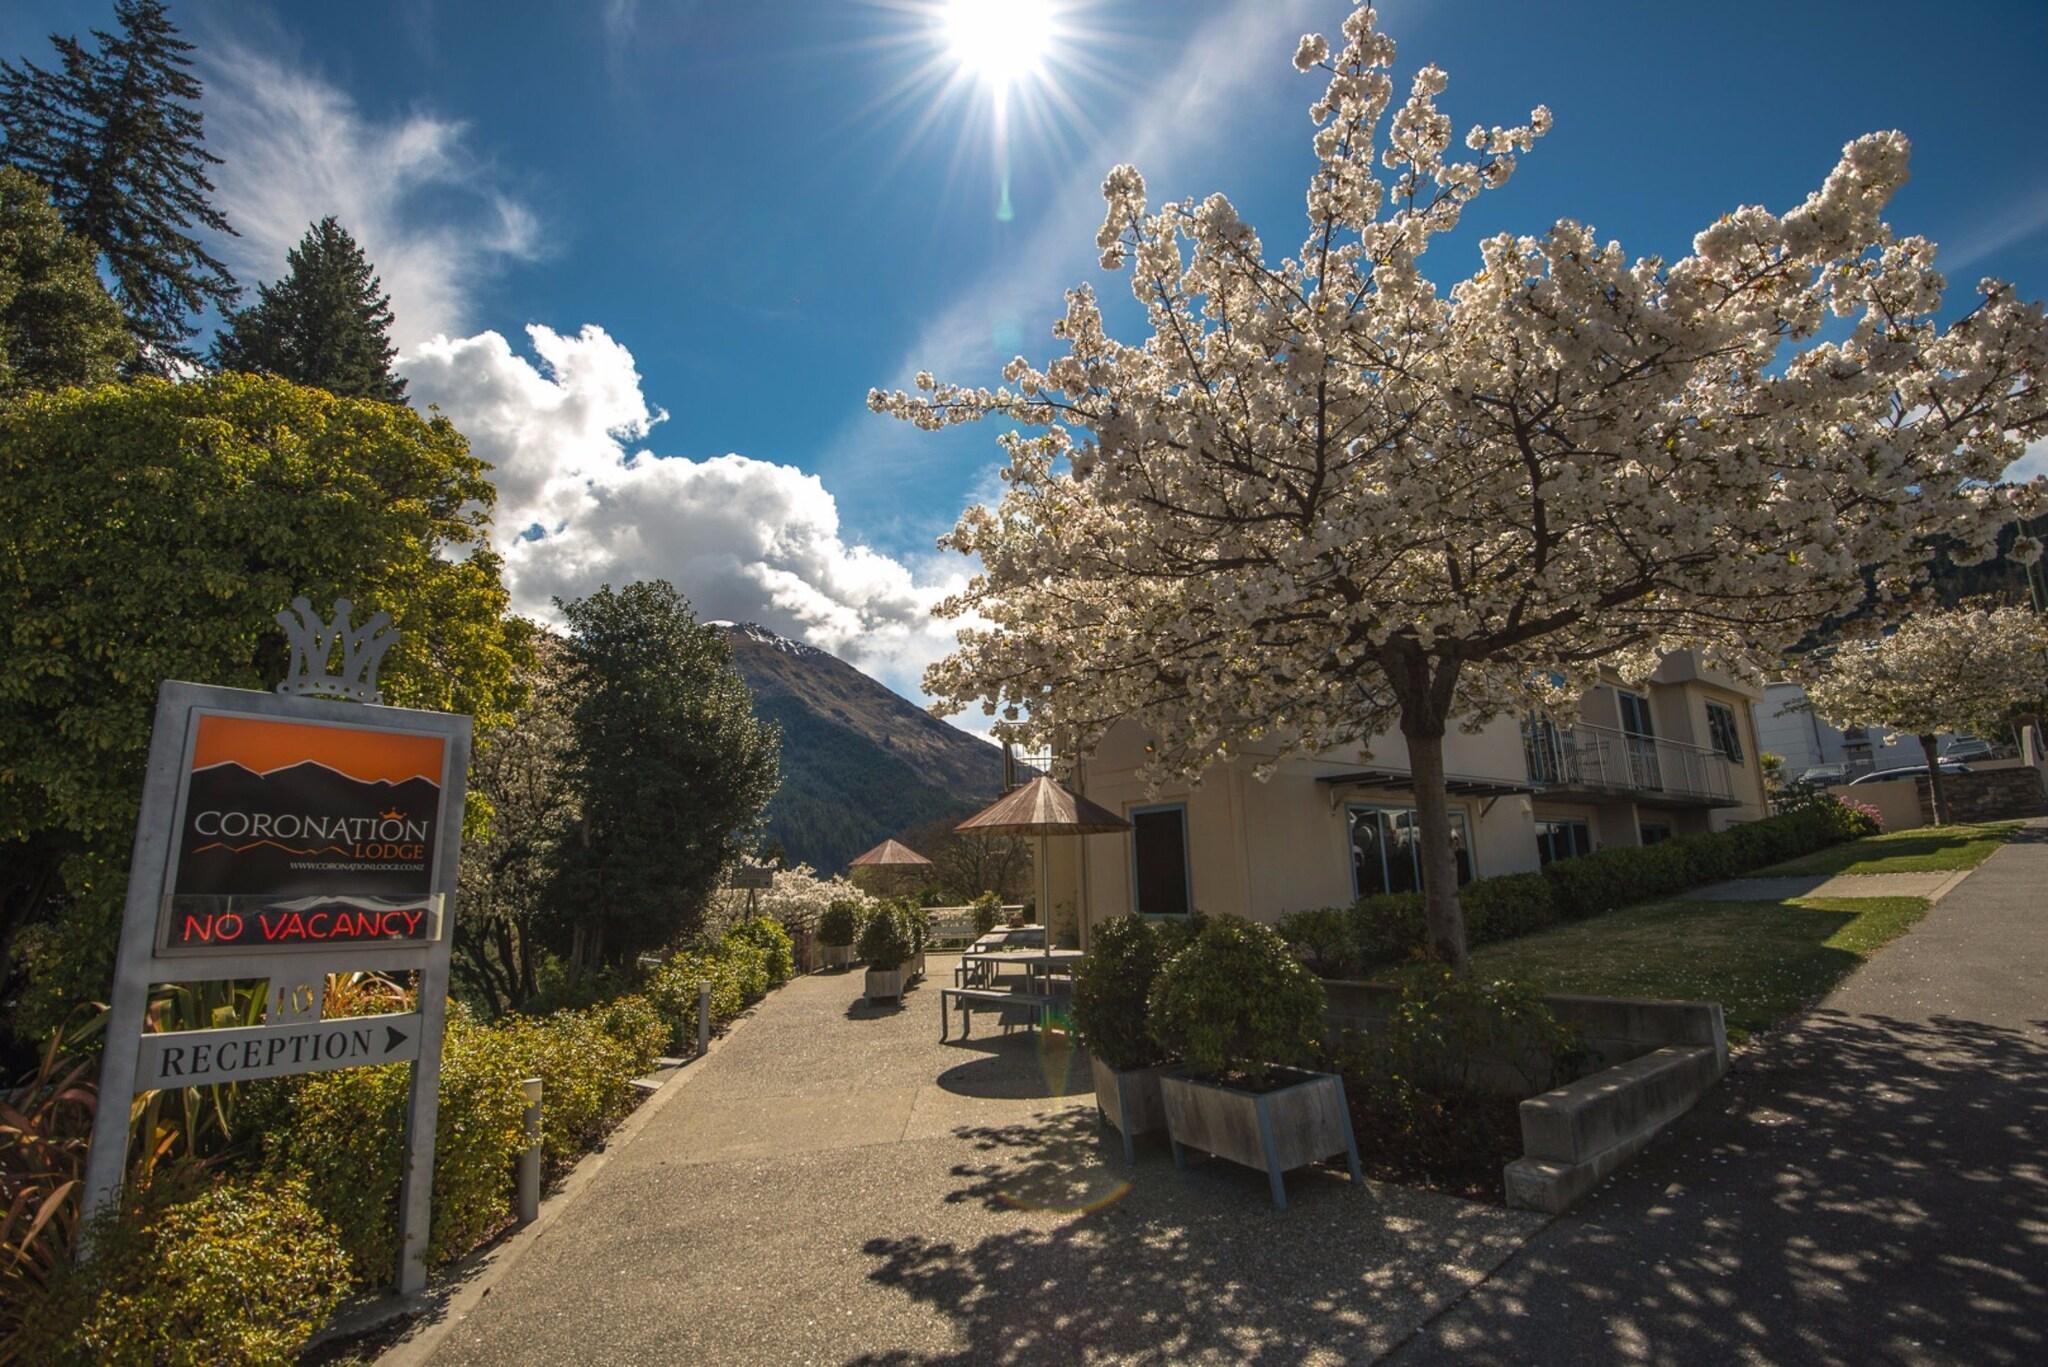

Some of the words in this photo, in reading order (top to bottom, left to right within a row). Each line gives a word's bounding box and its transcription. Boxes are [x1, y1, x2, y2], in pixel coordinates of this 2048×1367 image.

[194, 810, 431, 846] CORONATION
[290, 861, 425, 873] WWW.CORONATIONLODGE.CO.NZ
[354, 842, 425, 860] LODGE
[184, 912, 244, 942] NO
[259, 910, 423, 941] VACANCY
[158, 1028, 375, 1079] RECEPTION
